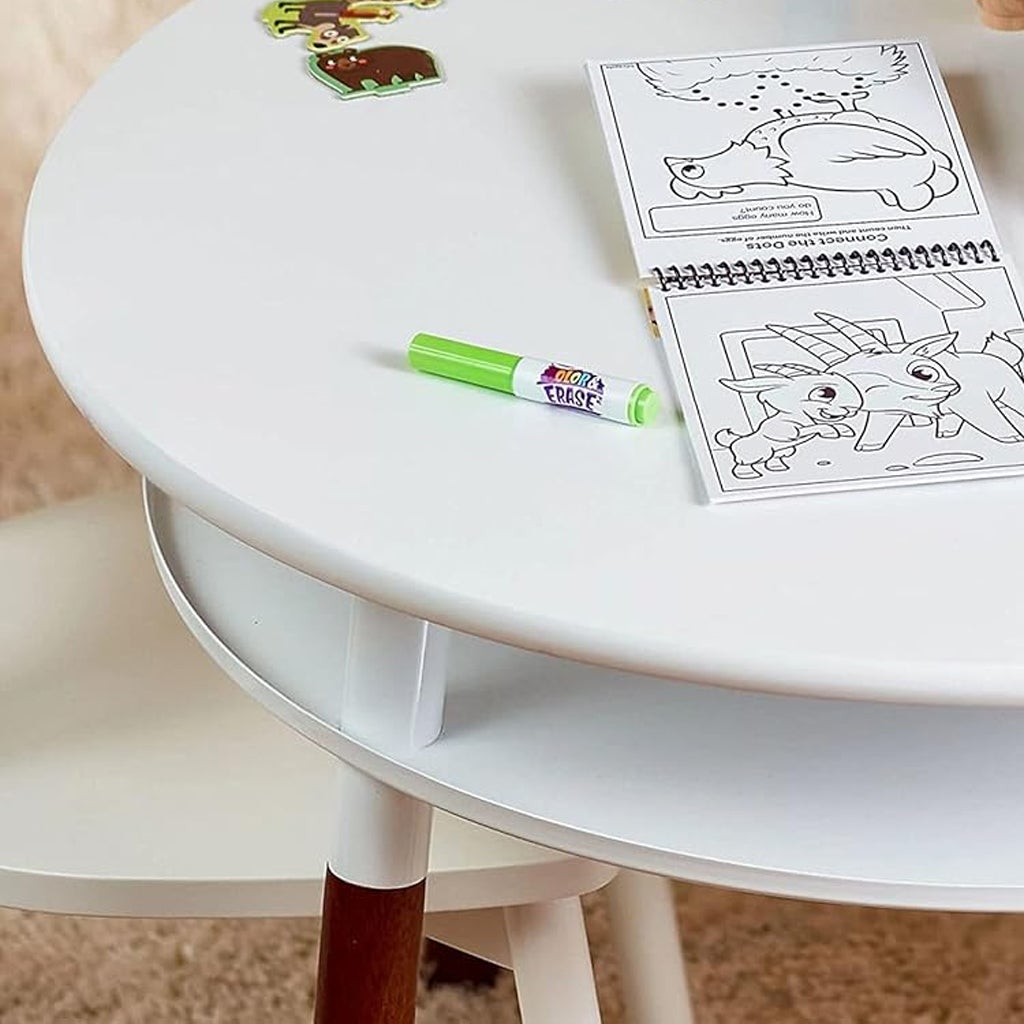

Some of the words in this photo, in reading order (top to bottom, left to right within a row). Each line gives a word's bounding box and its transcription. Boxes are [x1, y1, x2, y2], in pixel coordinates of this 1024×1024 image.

[740, 205, 775, 214] count?
[777, 203, 796, 211] you
[732, 214, 758, 222] eggs
[760, 212, 788, 220] many
[791, 210, 815, 218] How
[788, 239, 816, 248] the
[819, 233, 888, 246] Connect
[746, 240, 785, 250] Dots
[548, 367, 590, 387] OLOR
[544, 385, 599, 410] ERASE
